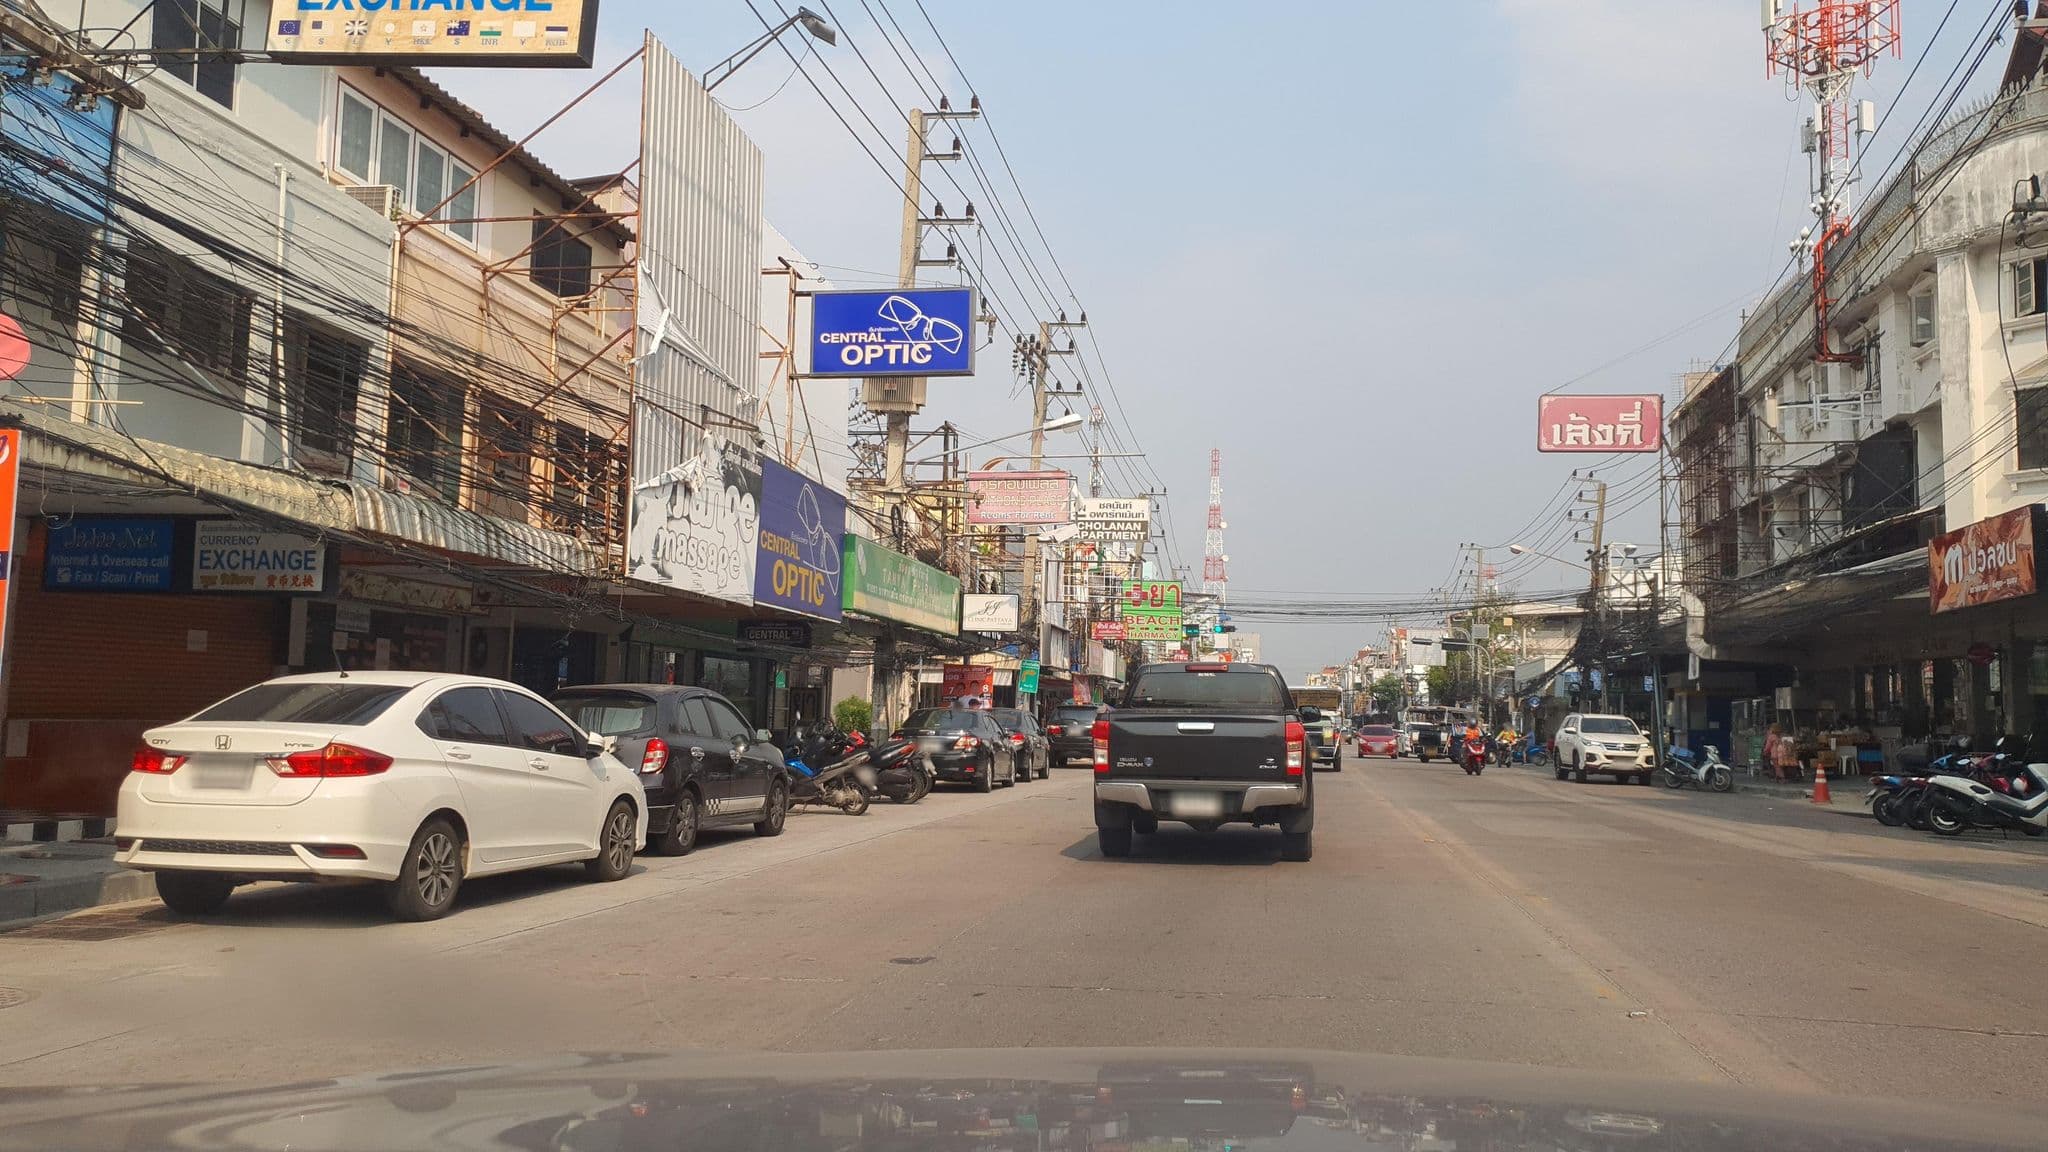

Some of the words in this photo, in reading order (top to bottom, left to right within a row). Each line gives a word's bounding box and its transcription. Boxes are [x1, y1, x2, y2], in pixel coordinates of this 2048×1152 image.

[820, 332, 886, 344] CENTRAL
[841, 343, 932, 366] OPTIC
[1078, 522, 1141, 530] CHOLANAN
[200, 535, 262, 546] CURRENCY
[760, 529, 801, 560] CENTRAL
[101, 554, 148, 567] Overseas
[199, 550, 317, 570] EXCHANGE
[656, 527, 741, 588] massage
[134, 572, 160, 584] Print
[772, 559, 826, 606] OPTIC
[1150, 584, 1181, 608] ยา
[1125, 615, 1180, 625] BEACH
[749, 629, 791, 641] CENTRAL
[982, 684, 989, 693] 8
